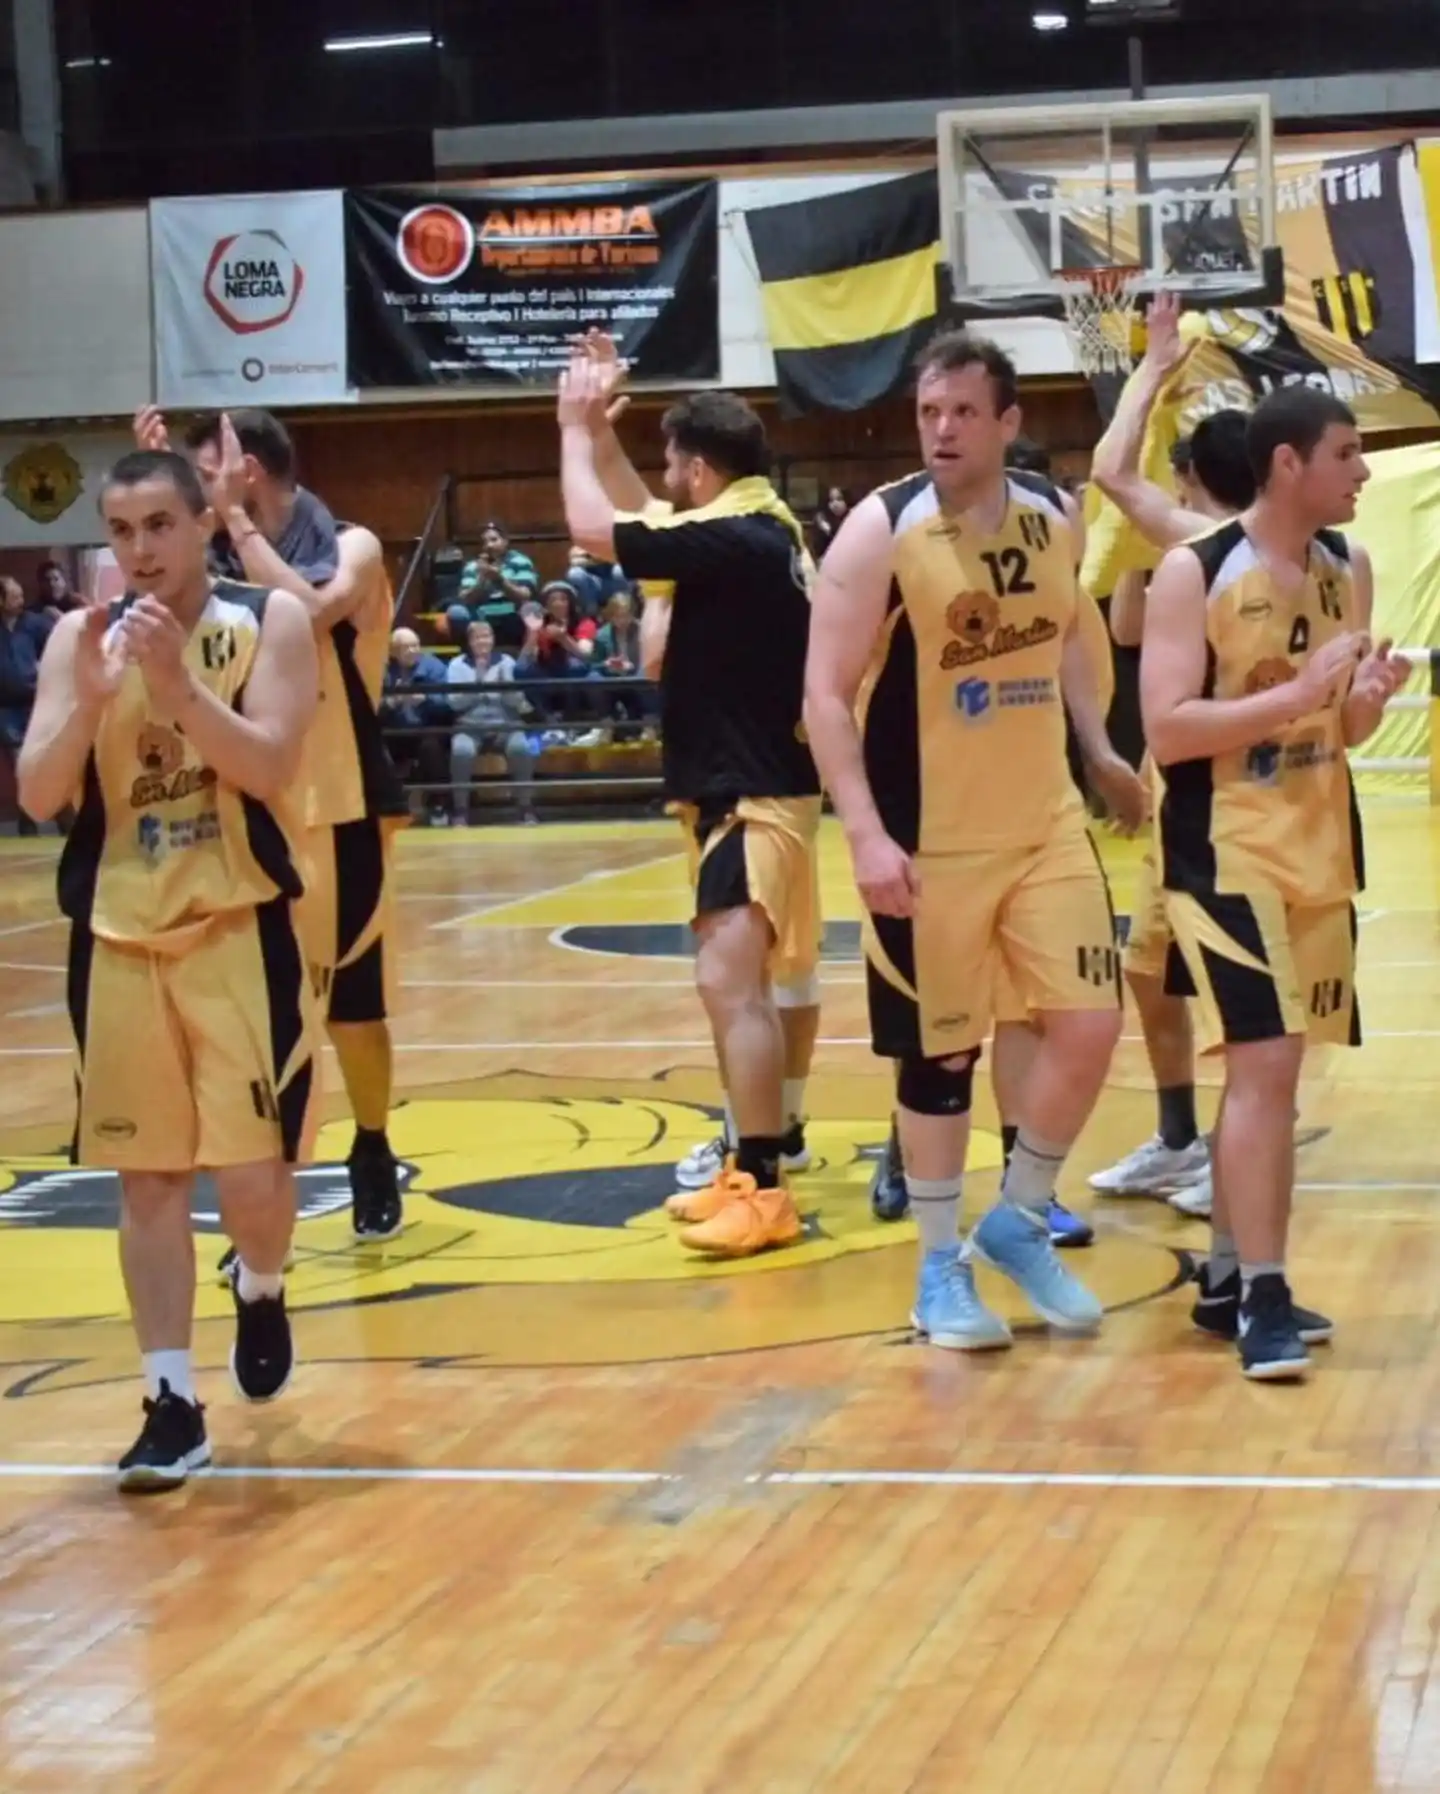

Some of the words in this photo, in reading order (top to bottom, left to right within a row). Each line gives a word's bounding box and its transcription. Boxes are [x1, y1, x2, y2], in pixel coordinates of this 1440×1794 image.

[479, 205, 659, 236] AMMBA
[224, 261, 280, 280] LOMA
[225, 280, 286, 299] NEGRA
[432, 290, 488, 305] cualquier
[579, 308, 608, 322] para
[980, 547, 1035, 597] 12
